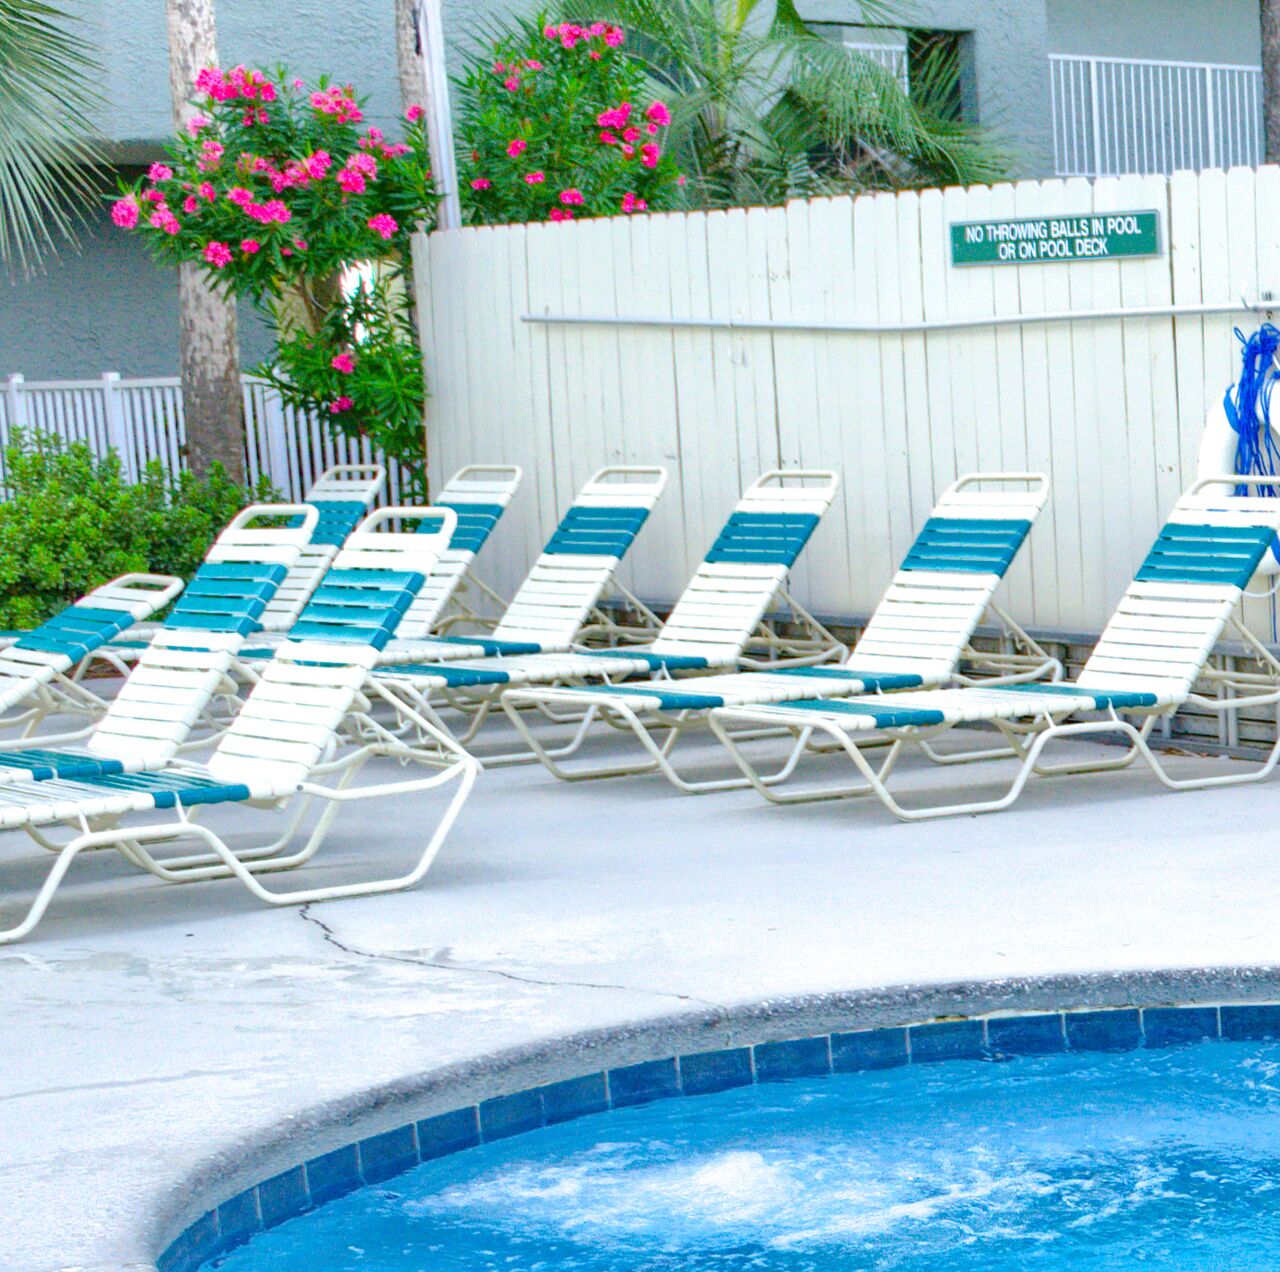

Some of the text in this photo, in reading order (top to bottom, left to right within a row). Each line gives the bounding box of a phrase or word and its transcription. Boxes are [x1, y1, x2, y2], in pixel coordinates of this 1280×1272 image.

[966, 217, 1142, 243] NO THROWING BALLS IN POOL
[999, 238, 1109, 260] OR ON POOL DECK
